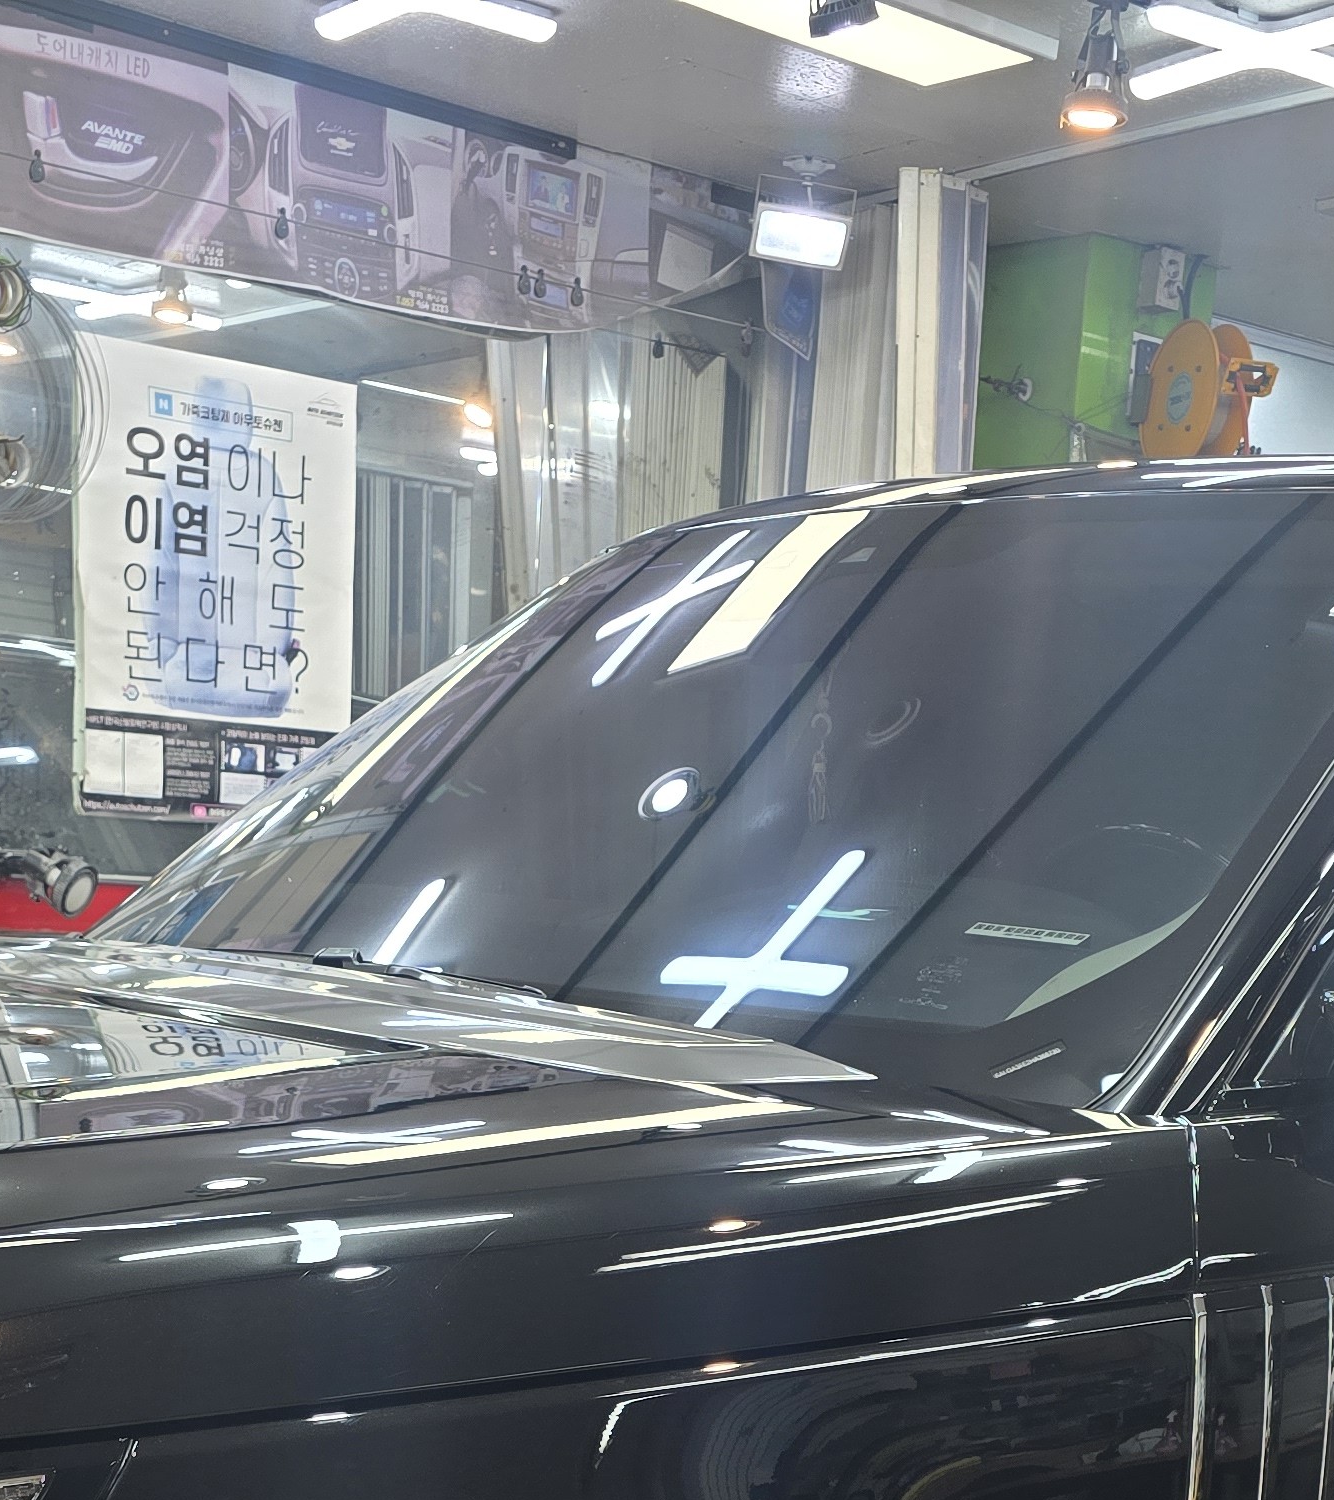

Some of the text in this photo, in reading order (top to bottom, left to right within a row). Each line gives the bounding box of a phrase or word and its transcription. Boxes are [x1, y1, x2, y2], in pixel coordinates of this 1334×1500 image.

[126, 57, 151, 79] LED
[81, 120, 146, 145] AVANTE
[124, 494, 305, 571] 이염 걱정
